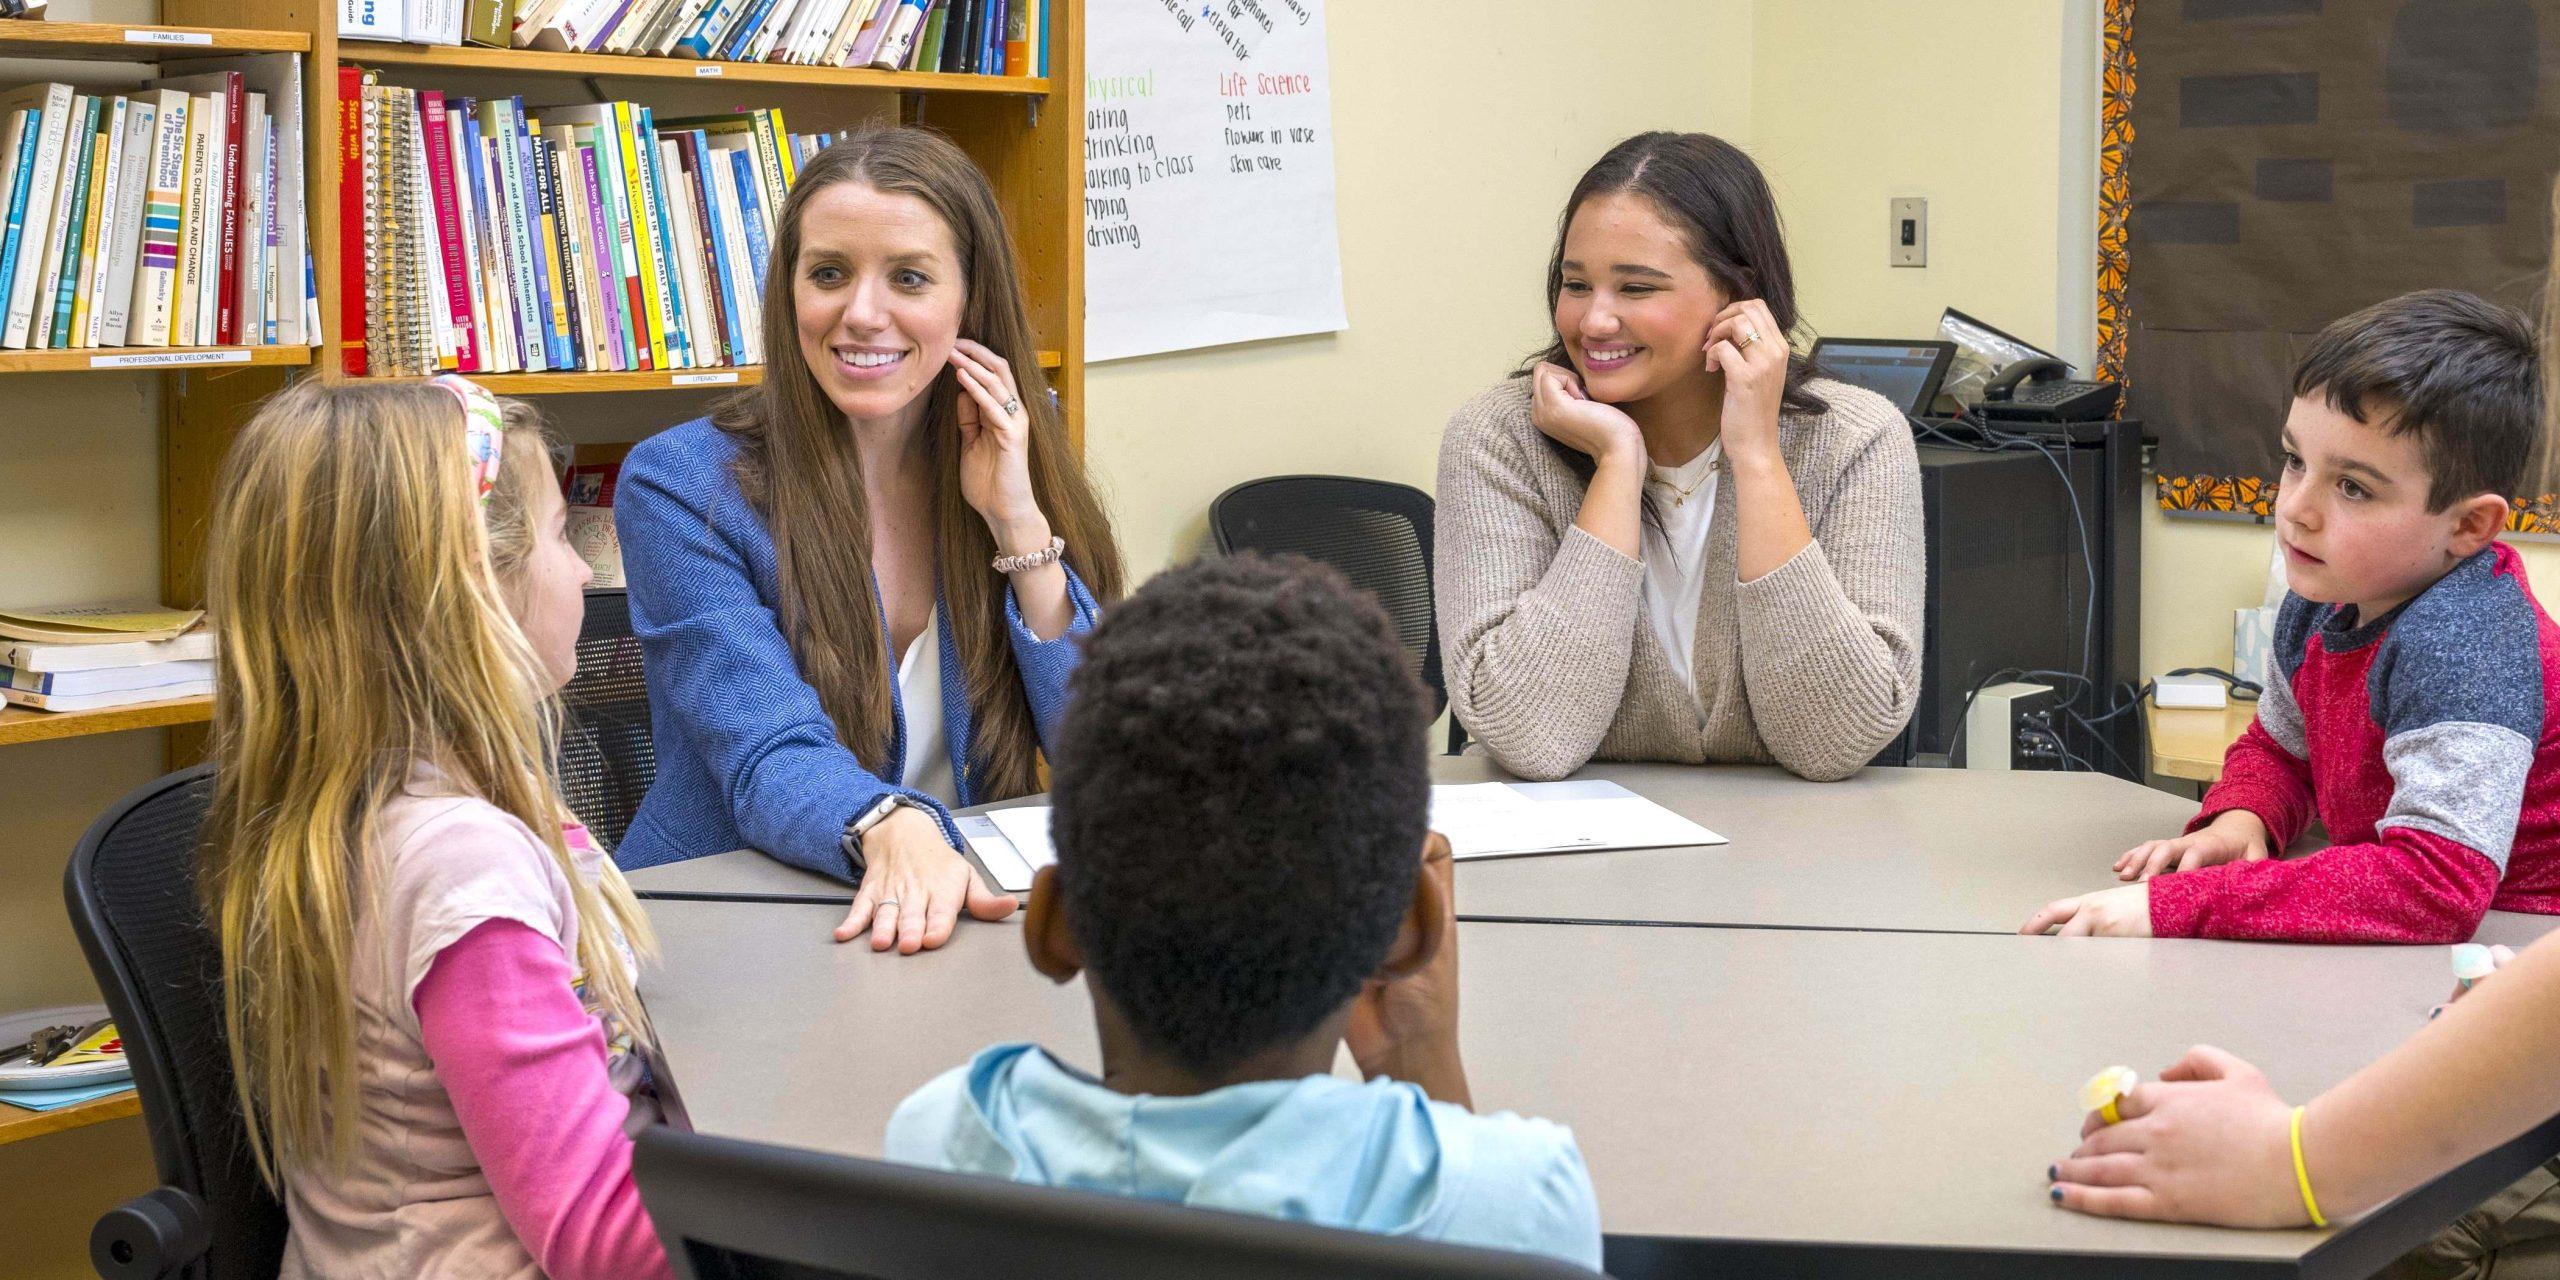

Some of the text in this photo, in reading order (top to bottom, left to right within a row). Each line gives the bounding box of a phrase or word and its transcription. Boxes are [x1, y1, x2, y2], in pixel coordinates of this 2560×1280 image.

[1176, 8, 1195, 32] call
[1209, 11, 1250, 61] elevator
[152, 33, 185, 42] FAMILIES
[1088, 68, 1153, 104] hysical
[1220, 72, 1311, 96] Life Science
[87, 109, 95, 128] Parent
[1226, 102, 1251, 122] pets
[349, 100, 359, 159] Start with
[432, 126, 446, 162] TEACHING
[1224, 126, 1314, 146] flowers in vase
[69, 147, 78, 162] and
[111, 149, 119, 163] and
[159, 113, 174, 187] of Parenthood
[167, 113, 185, 188] The Six Stages
[502, 128, 516, 180] Elementary
[763, 124, 783, 199] Teaching Math to
[1257, 156, 1282, 170] care
[38, 168, 52, 193] view
[65, 163, 75, 182] Early
[75, 174, 86, 198] Teaching
[107, 166, 117, 184] Early
[210, 164, 218, 187] Child
[437, 163, 452, 212] ELEMENTARY
[532, 135, 550, 212] MATH FOR ALL
[1085, 156, 1194, 190] alking to class
[60, 183, 72, 217] Childhood
[104, 185, 115, 218] Childhood
[128, 155, 146, 230] Building Effective
[223, 143, 237, 253] Understanding FAMILIES
[479, 176, 490, 219] Understanding
[510, 181, 519, 198] and
[585, 154, 606, 254] It's the Story That Counts
[186, 133, 204, 284] PARENTS, CHILDREN, AND CHANGE
[207, 207, 215, 229] Family
[267, 184, 276, 235] School
[513, 200, 523, 233] Middle
[549, 149, 575, 290] LIVING AND LEARNING MATHEMATICS
[617, 196, 632, 244] Preschool Math
[699, 202, 709, 232] ROUTINES
[751, 207, 761, 233] Math
[1085, 196, 1128, 221] typing
[53, 219, 66, 252] Programs
[86, 216, 95, 248] relations
[100, 220, 111, 252] Programs
[111, 210, 128, 267] Relationships
[443, 213, 456, 241] SCHOOL
[639, 149, 672, 322] MATHEMATICS IN THE EARLY YEARS
[1088, 222, 1140, 249] driving
[517, 234, 527, 264] School
[47, 271, 57, 292] Powell
[95, 272, 104, 293] Powell
[156, 270, 167, 300] Galinsky
[203, 256, 212, 293] Community
[446, 243, 465, 307] MATHEMATICS
[520, 265, 534, 323] Mathematics
[697, 247, 706, 269] Creating
[703, 281, 711, 297] Space
[709, 308, 718, 341] Construction
[40, 315, 50, 339] NAEYC
[90, 315, 99, 339] NAEYC
[120, 352, 225, 364] PROFESSIONAL DEVELOPMENT
